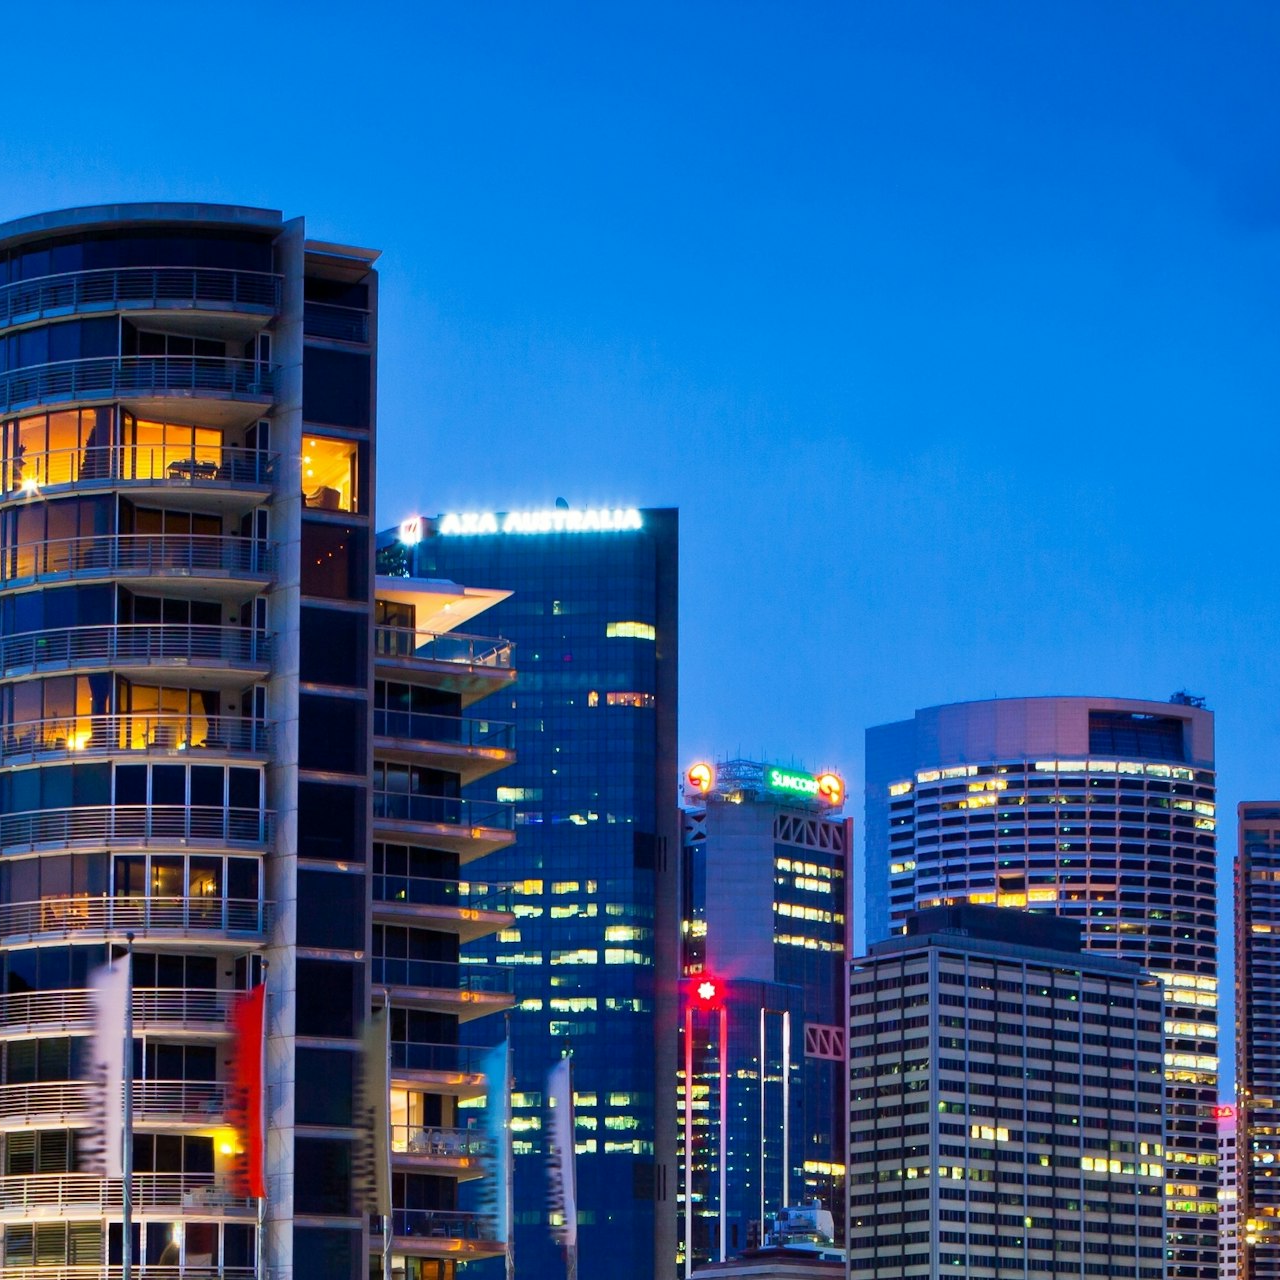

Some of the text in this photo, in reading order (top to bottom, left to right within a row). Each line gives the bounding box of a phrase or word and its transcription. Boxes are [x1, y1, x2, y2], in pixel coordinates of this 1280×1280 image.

[439, 508, 644, 534] AXA AUSTRALIA
[772, 770, 820, 794] SUNCORP
